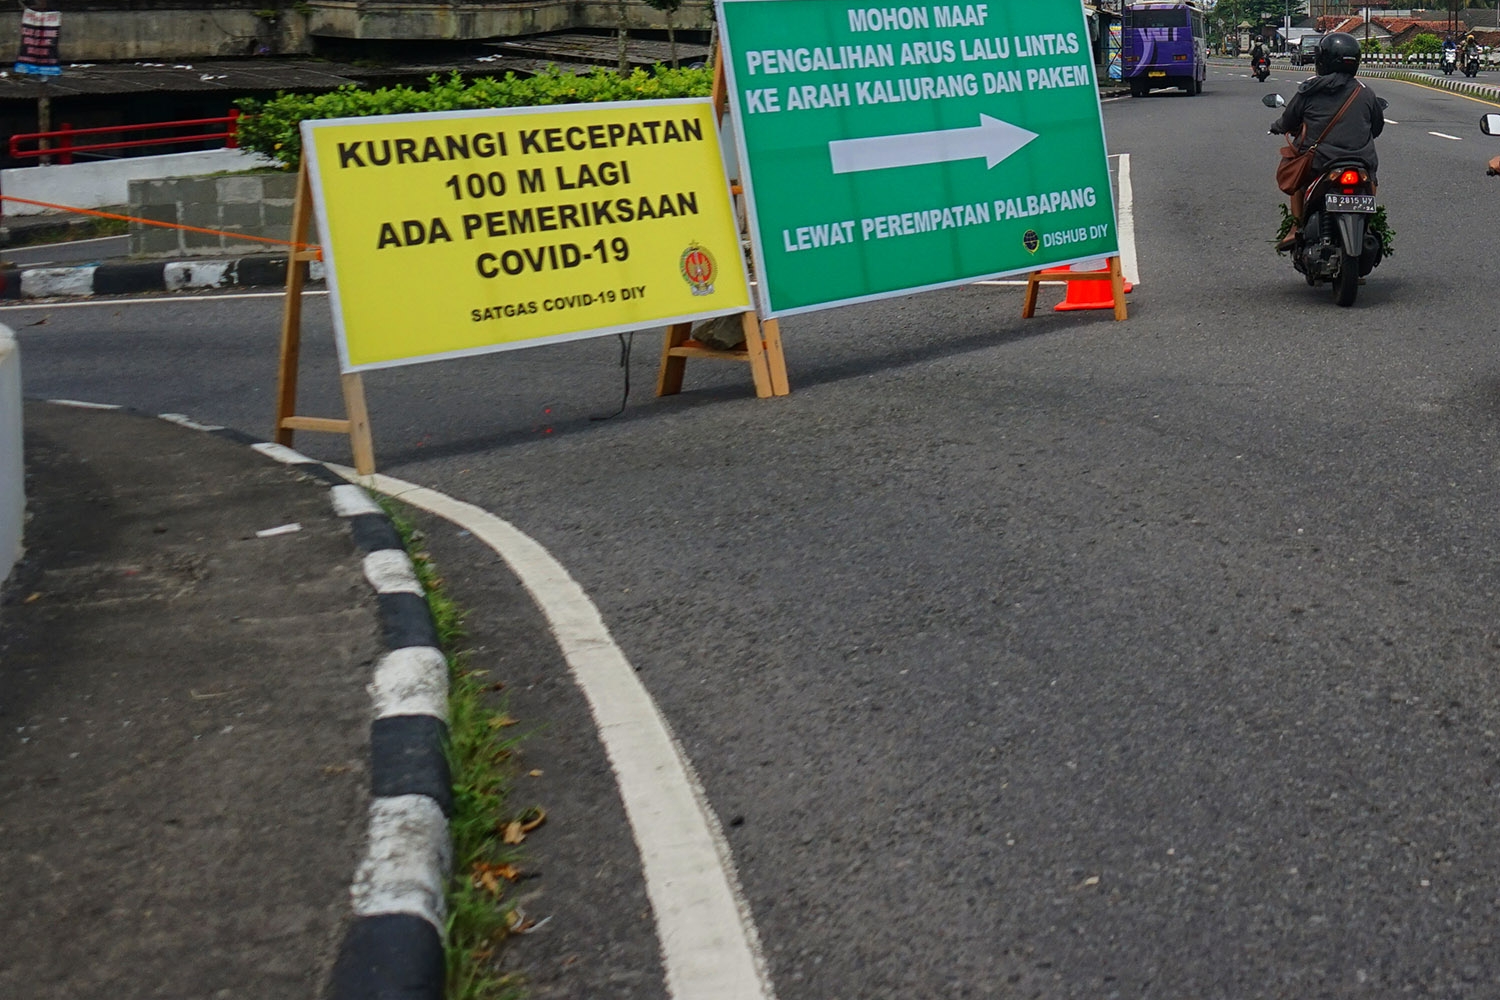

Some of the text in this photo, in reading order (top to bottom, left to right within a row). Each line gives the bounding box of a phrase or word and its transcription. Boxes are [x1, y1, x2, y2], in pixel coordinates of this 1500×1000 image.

[847, 3, 989, 32] MOHON MAAF
[745, 45, 895, 76] PENGALIHAN
[899, 39, 956, 66] ARUS
[960, 36, 1010, 62] LALU
[1014, 32, 1080, 58] LINTAS
[745, 64, 1091, 114] KE ARAH KALIURANG DAN PAKEM
[337, 117, 704, 170] KURANGI KECEPATAN
[445, 159, 631, 201] 100 M LAGI
[376, 191, 700, 250] ADA PEMERIKSAAN
[782, 186, 1097, 253] LEWAT PEREMPATAN PALBAPANG
[1042, 223, 1109, 249] DISHUB DIY
[476, 236, 630, 279] COVID-19
[471, 285, 647, 323] SATGAS COVID-19 DIY
